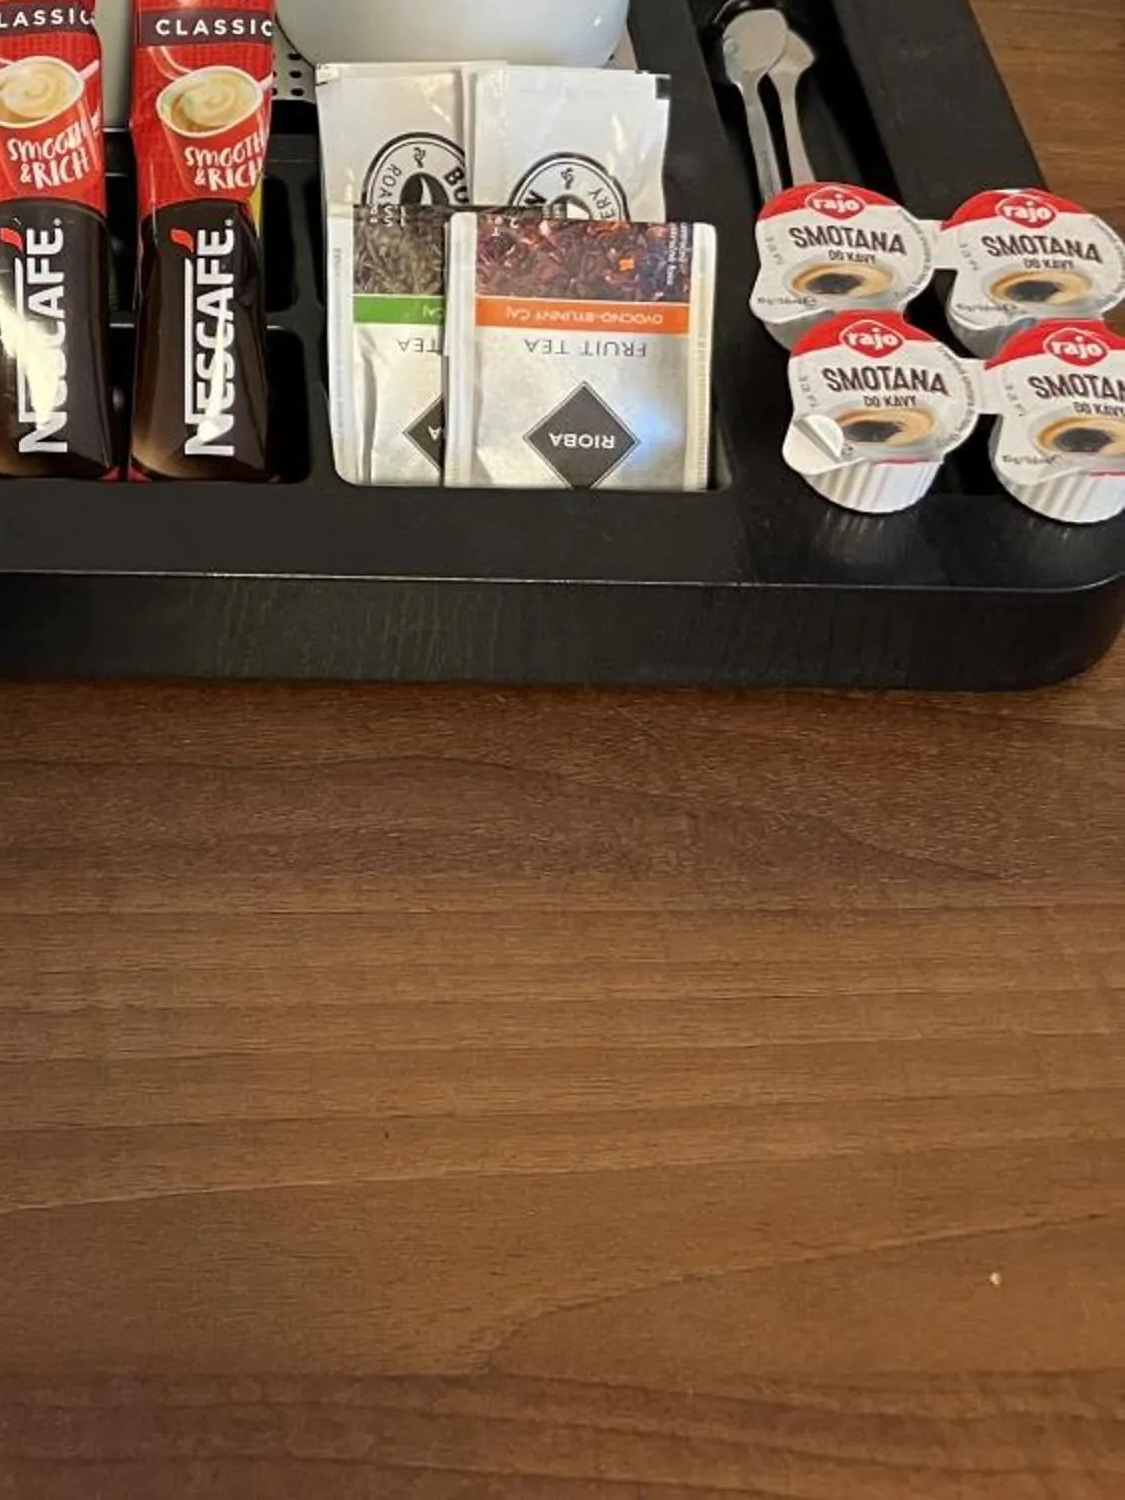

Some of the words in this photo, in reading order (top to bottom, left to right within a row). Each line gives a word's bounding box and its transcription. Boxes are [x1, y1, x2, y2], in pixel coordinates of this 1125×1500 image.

[155, 19, 273, 37] CLASSIC
[811, 193, 860, 213] rajo
[1002, 200, 1051, 223] rajo
[788, 225, 907, 257] SMOTANA
[981, 235, 1103, 264] SMOTANA
[397, 338, 442, 354] TEA
[523, 337, 571, 355] TEA
[582, 340, 648, 357] FRUIT
[845, 327, 898, 350] rajo
[1050, 335, 1104, 359] rajo
[823, 366, 951, 397] SMOTANA
[548, 432, 616, 450] RIOBA
